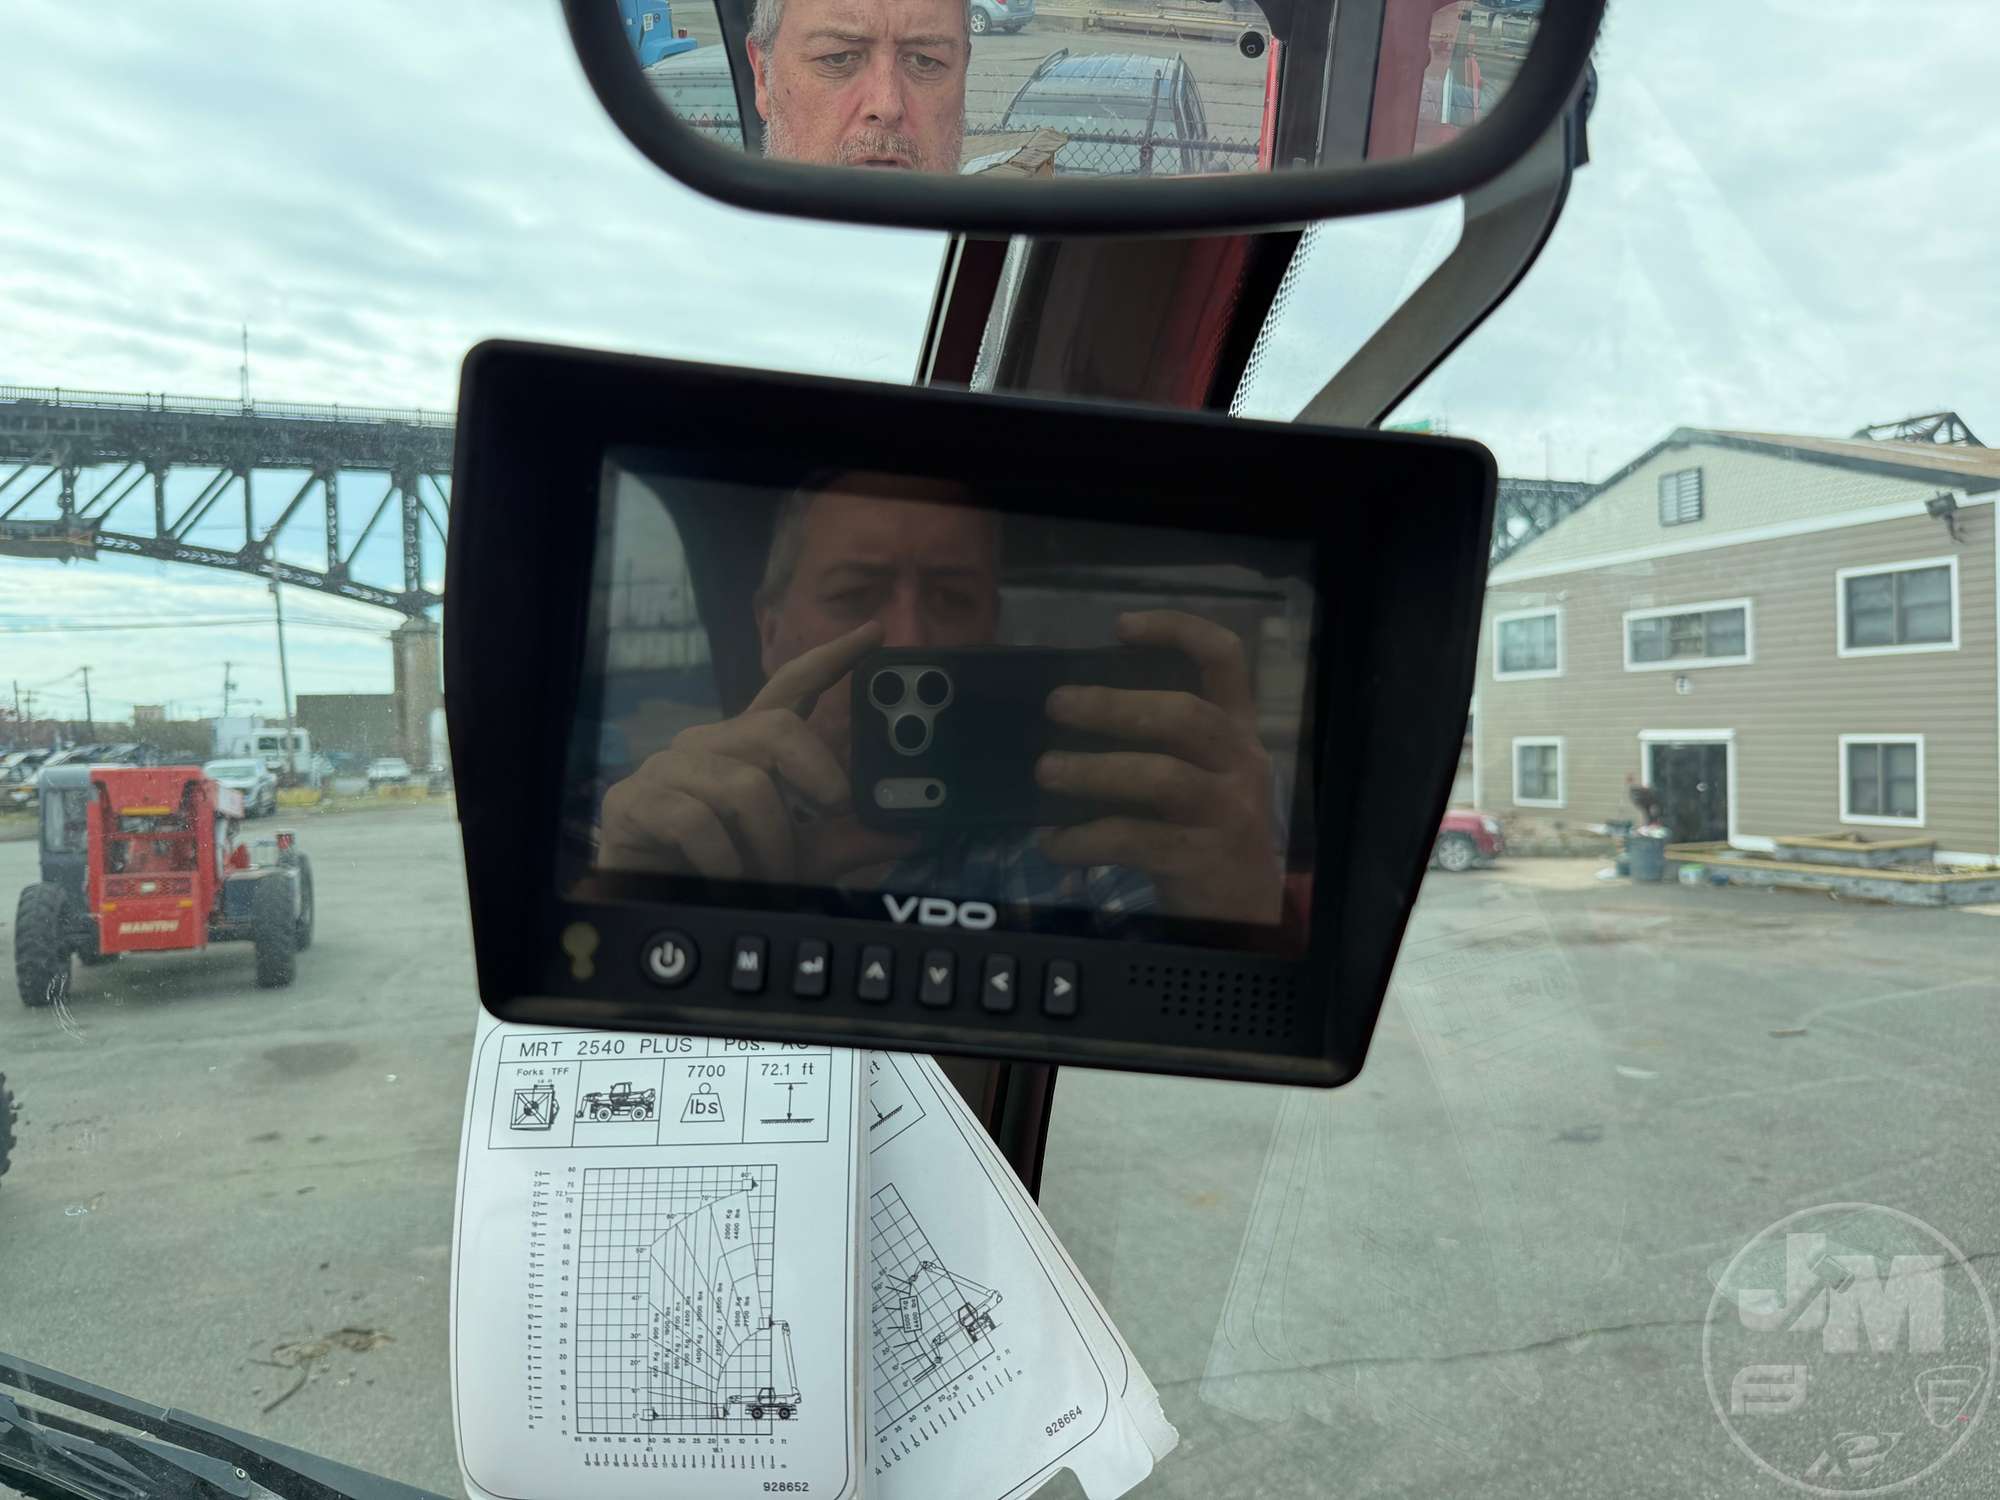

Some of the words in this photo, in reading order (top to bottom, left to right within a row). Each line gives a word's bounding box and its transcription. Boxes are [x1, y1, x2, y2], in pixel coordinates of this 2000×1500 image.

[882, 894, 998, 930] VDO
[737, 951, 759, 971] M
[520, 1042, 563, 1057] MRT
[577, 1040, 624, 1055] 2540
[640, 1038, 692, 1054] PLUS
[687, 1064, 726, 1078] 7700
[761, 1063, 790, 1076] 72.1
[802, 1062, 814, 1075] ft
[690, 1099, 719, 1114] lbs
[1045, 1405, 1082, 1436] 928664
[763, 1482, 809, 1492] 928652
